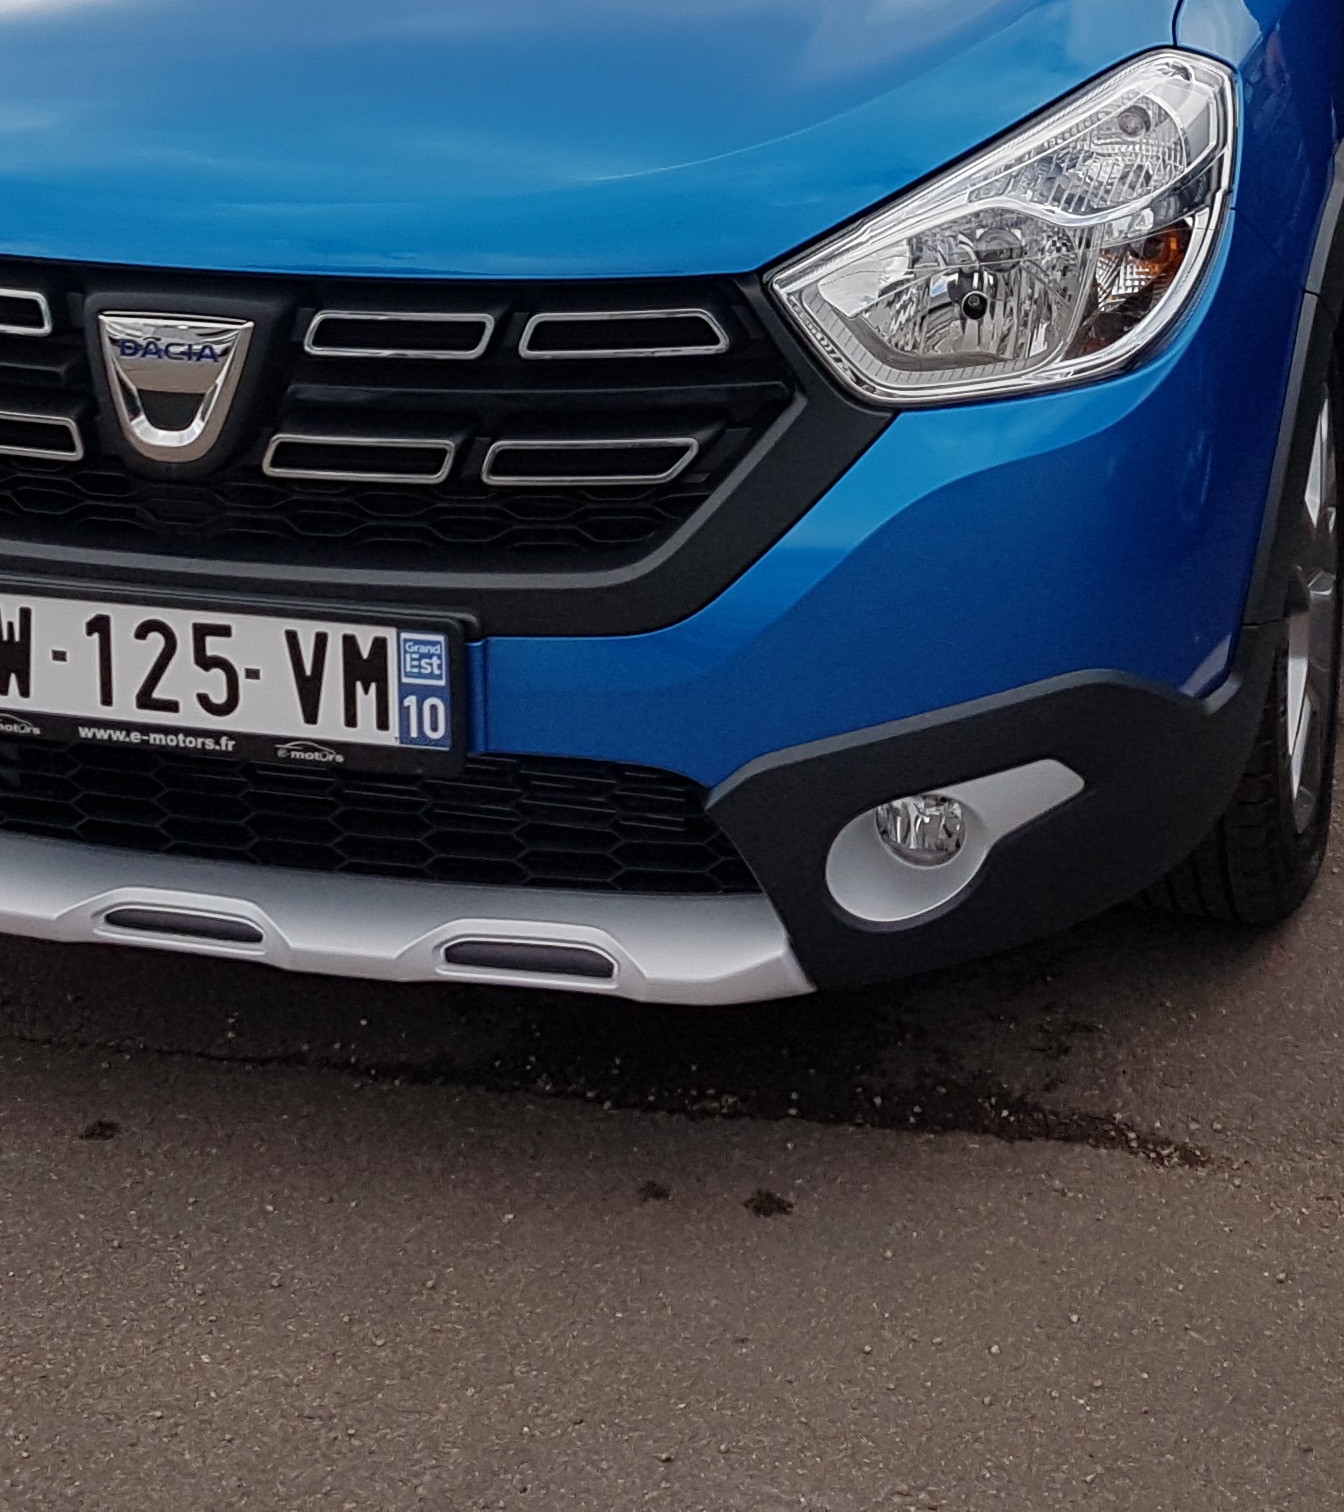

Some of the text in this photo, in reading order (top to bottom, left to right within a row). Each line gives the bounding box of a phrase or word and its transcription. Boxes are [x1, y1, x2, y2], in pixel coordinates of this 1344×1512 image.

[119, 338, 219, 363] DACIA
[404, 641, 441, 654] Grand
[405, 653, 441, 675] Est
[402, 694, 446, 740] 10
[78, 726, 236, 751] www.e-motors.fr
